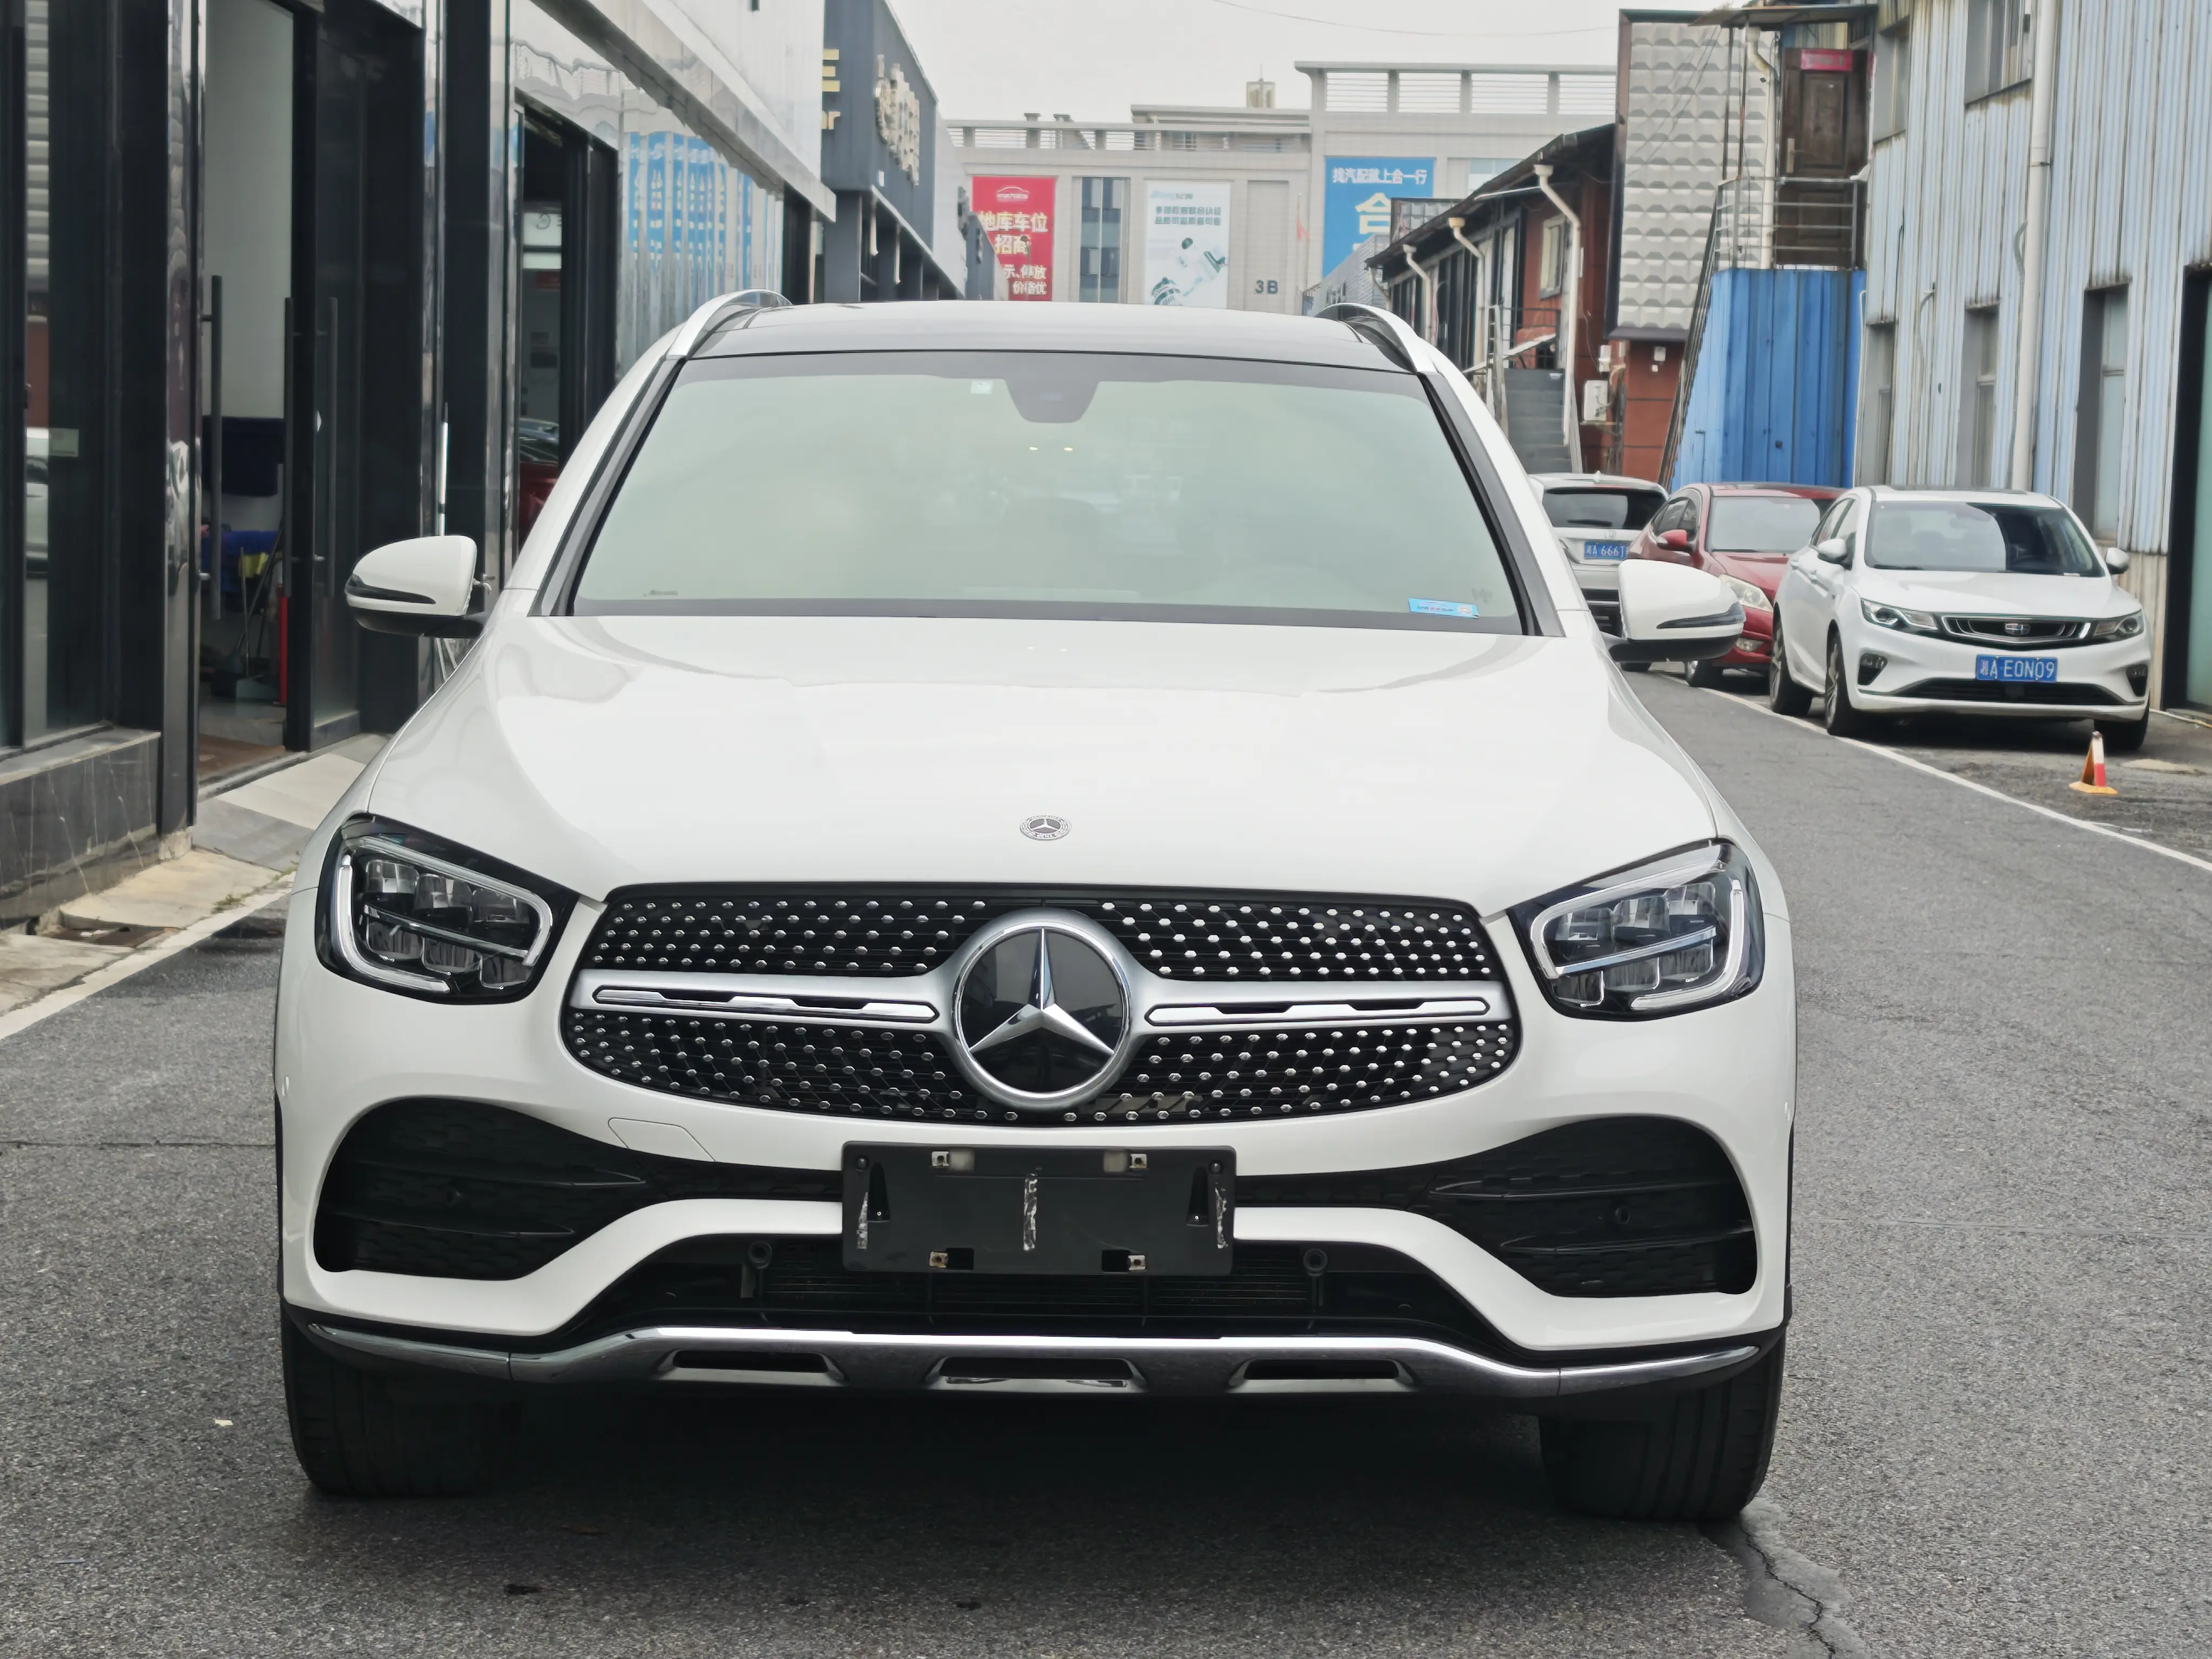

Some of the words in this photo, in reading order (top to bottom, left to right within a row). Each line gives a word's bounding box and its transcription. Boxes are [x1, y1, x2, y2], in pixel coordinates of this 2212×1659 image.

[976, 210, 1049, 233] 地库车位
[1255, 279, 1278, 295] 3B
